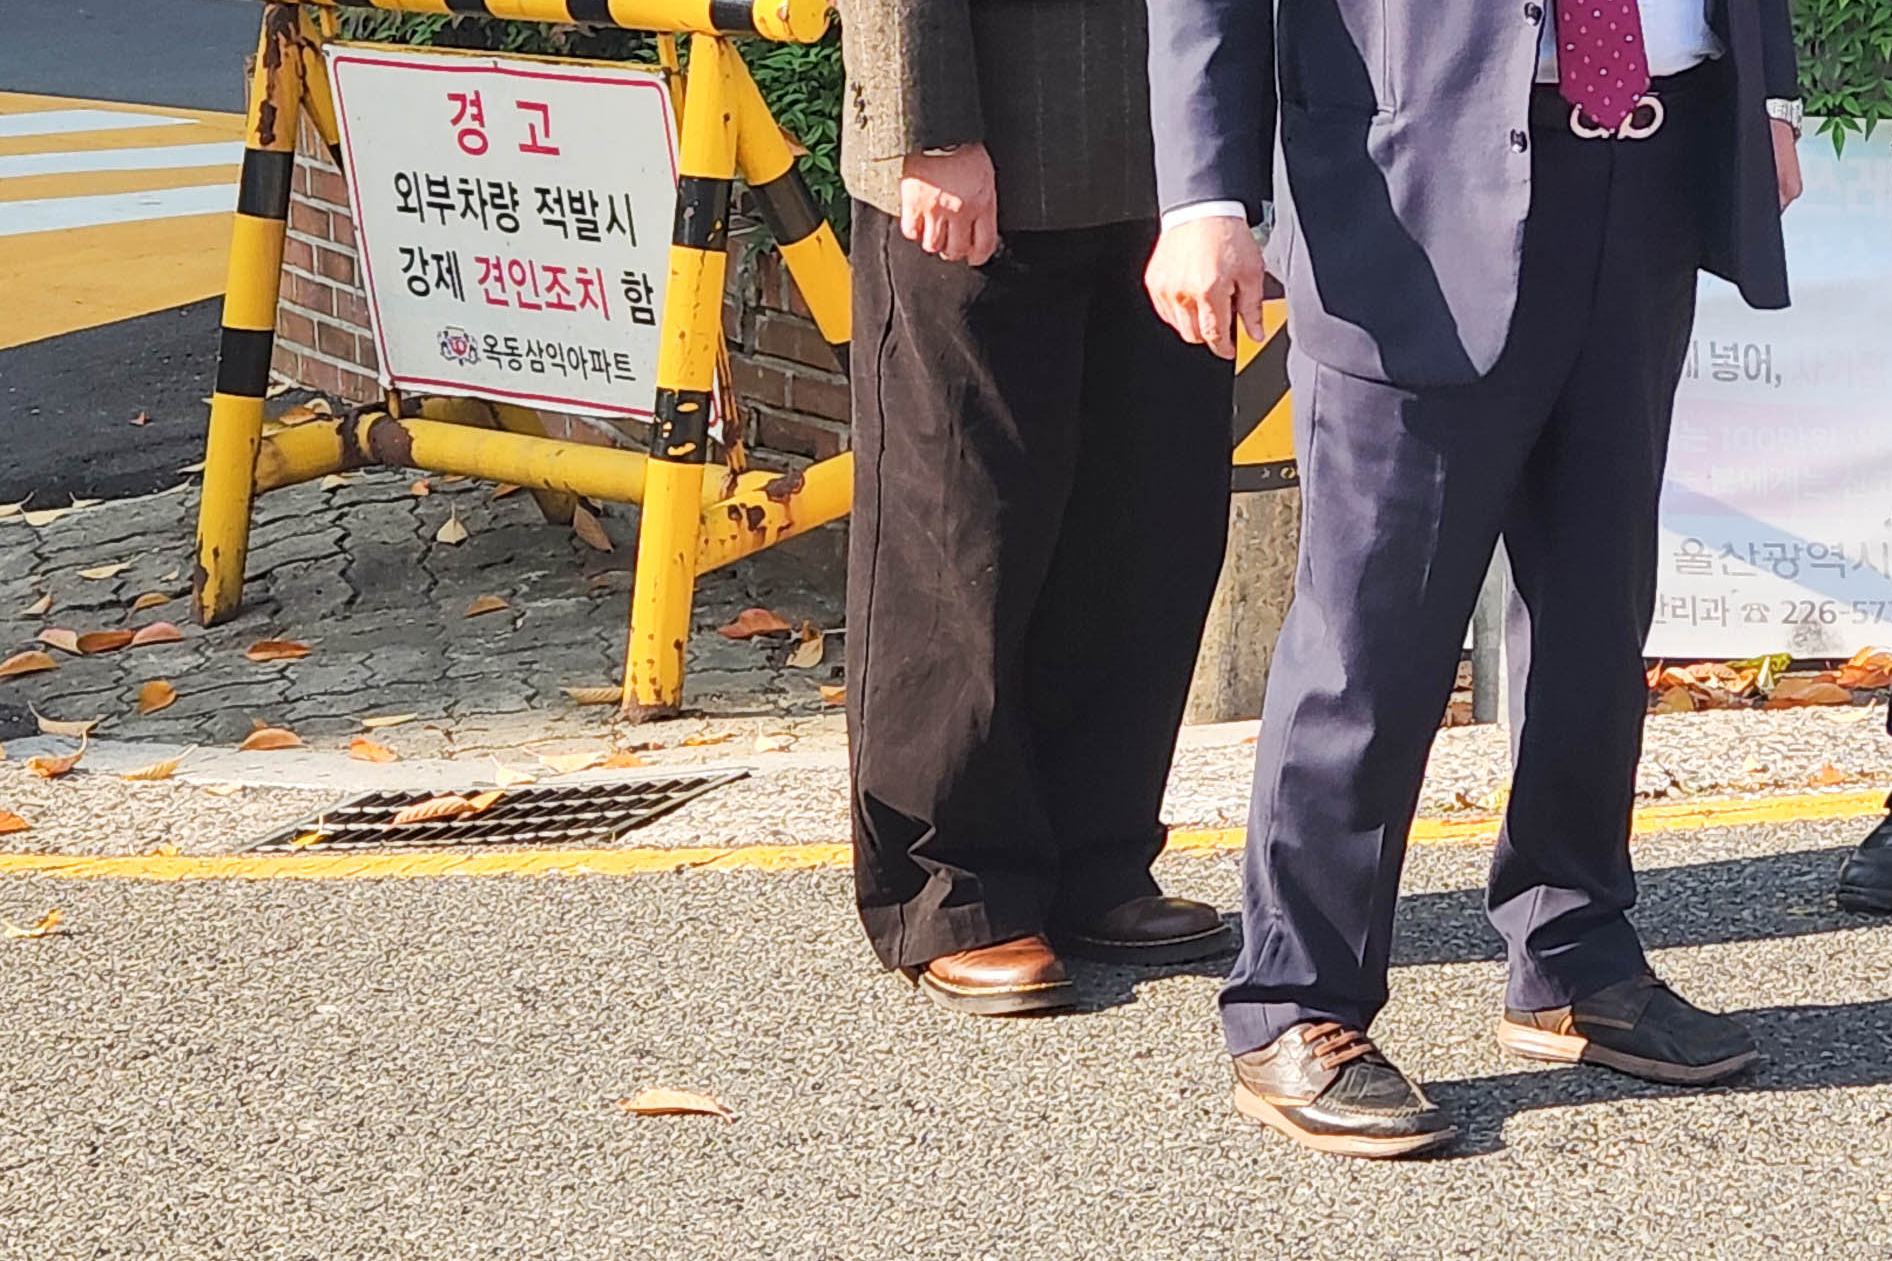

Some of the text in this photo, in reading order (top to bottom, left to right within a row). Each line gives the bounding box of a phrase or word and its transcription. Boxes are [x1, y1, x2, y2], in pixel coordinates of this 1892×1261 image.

[393, 170, 638, 248] 외부차량 적발시
[399, 245, 657, 327] 강제 견인조치 함
[482, 332, 637, 385] 옥동삼익아파트
[1710, 341, 1782, 388] 넣어,
[1673, 537, 1891, 579] 울산광역시
